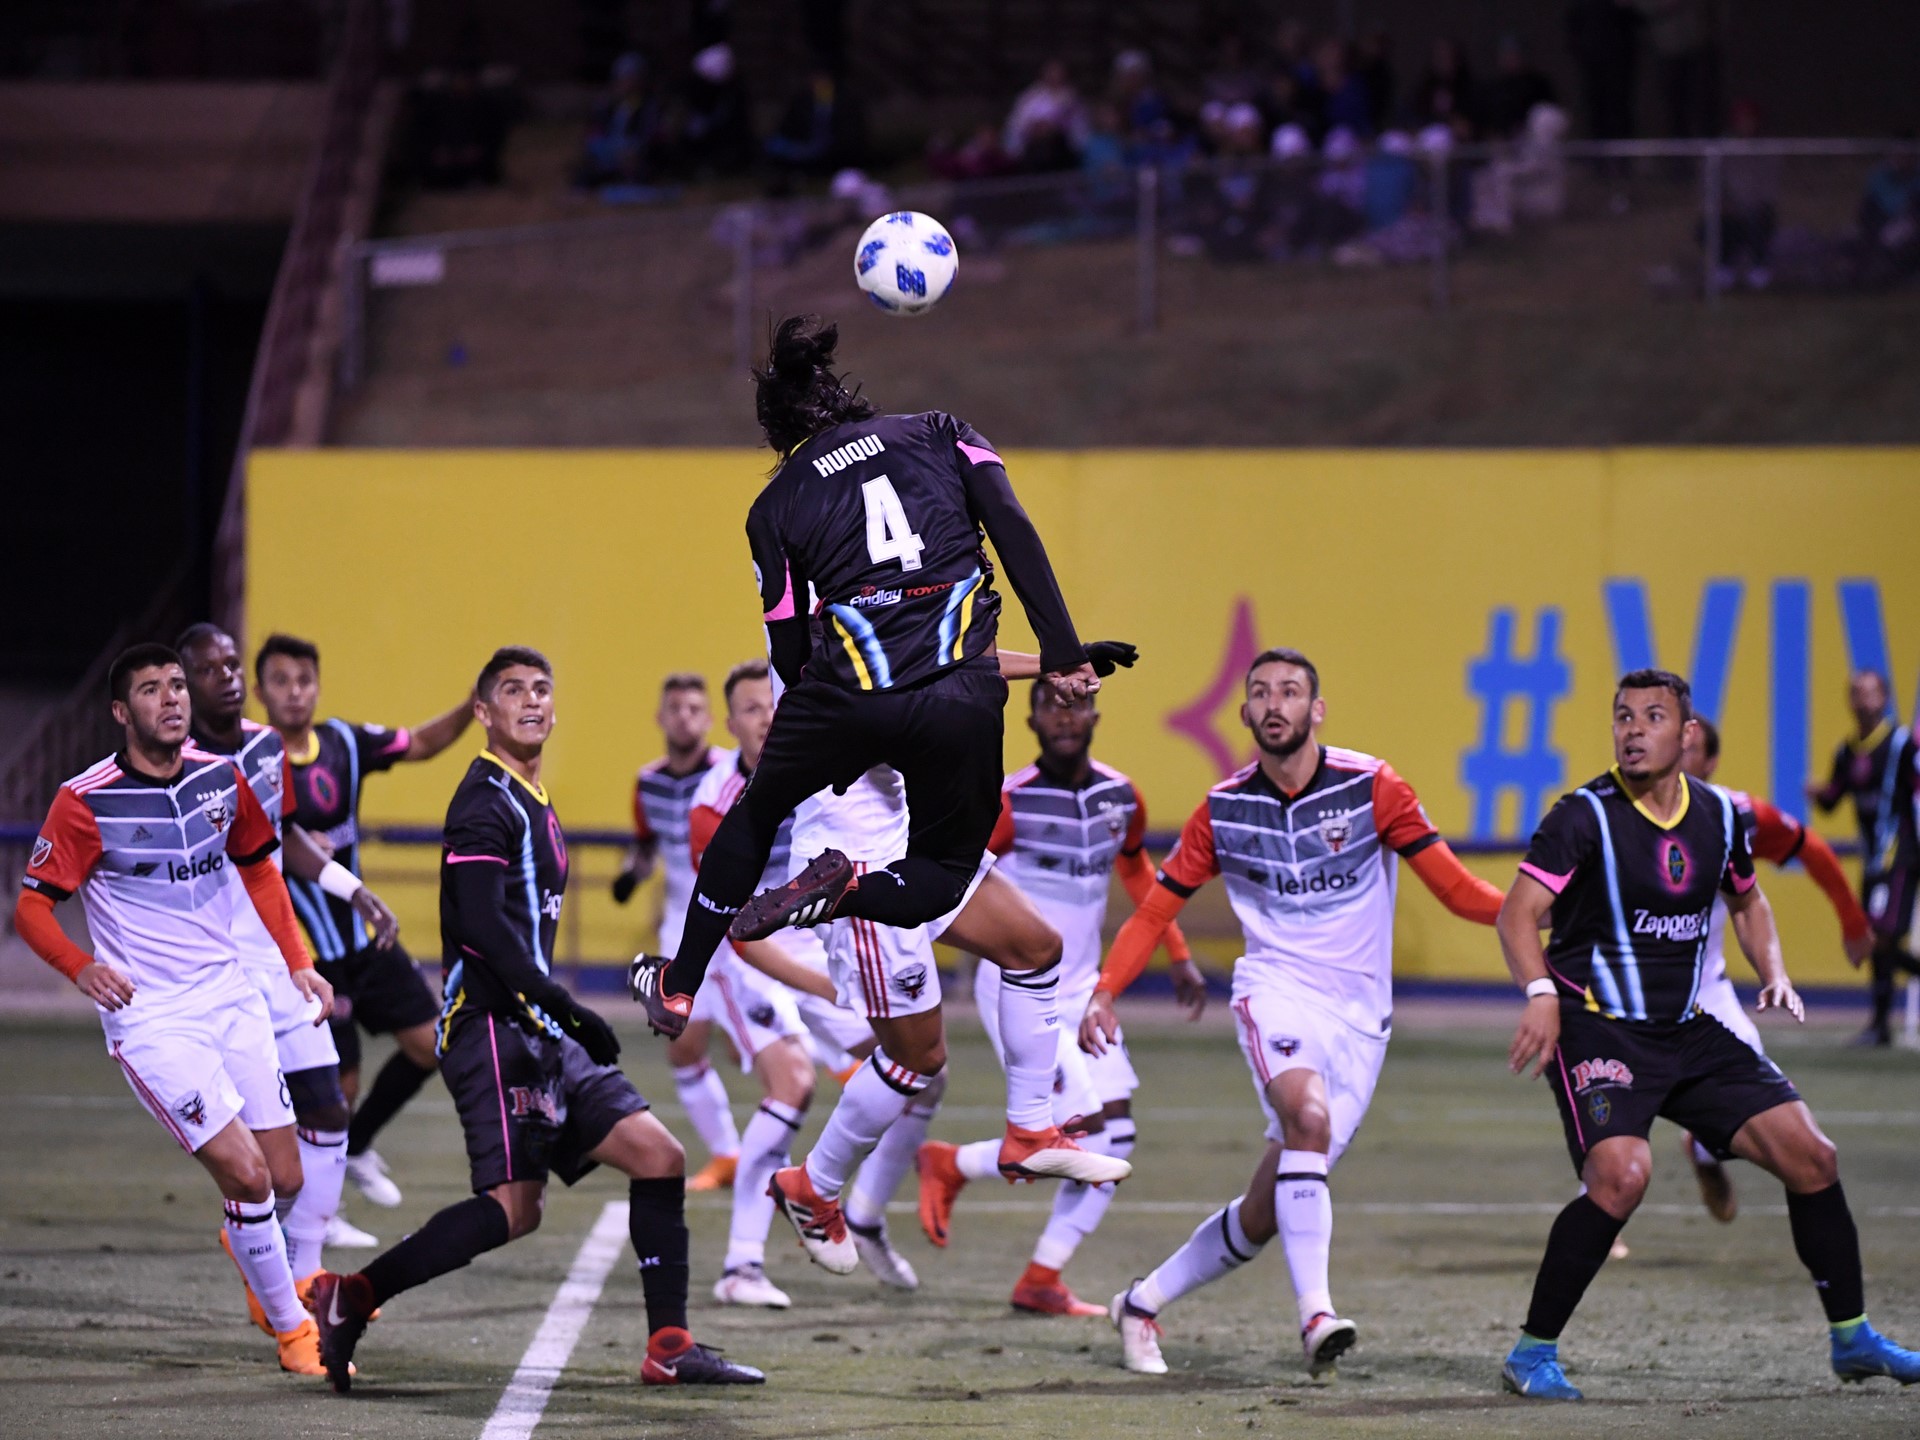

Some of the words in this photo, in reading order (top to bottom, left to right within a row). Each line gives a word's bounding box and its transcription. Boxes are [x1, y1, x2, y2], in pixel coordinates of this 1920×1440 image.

[812, 433, 885, 478] HUIQUI
[860, 474, 925, 572] 4
[850, 588, 902, 608] Findlay
[905, 582, 955, 599] TOYOT
[168, 852, 223, 884] leido
[1275, 866, 1358, 896] leidos
[1632, 908, 1699, 939] Zappos
